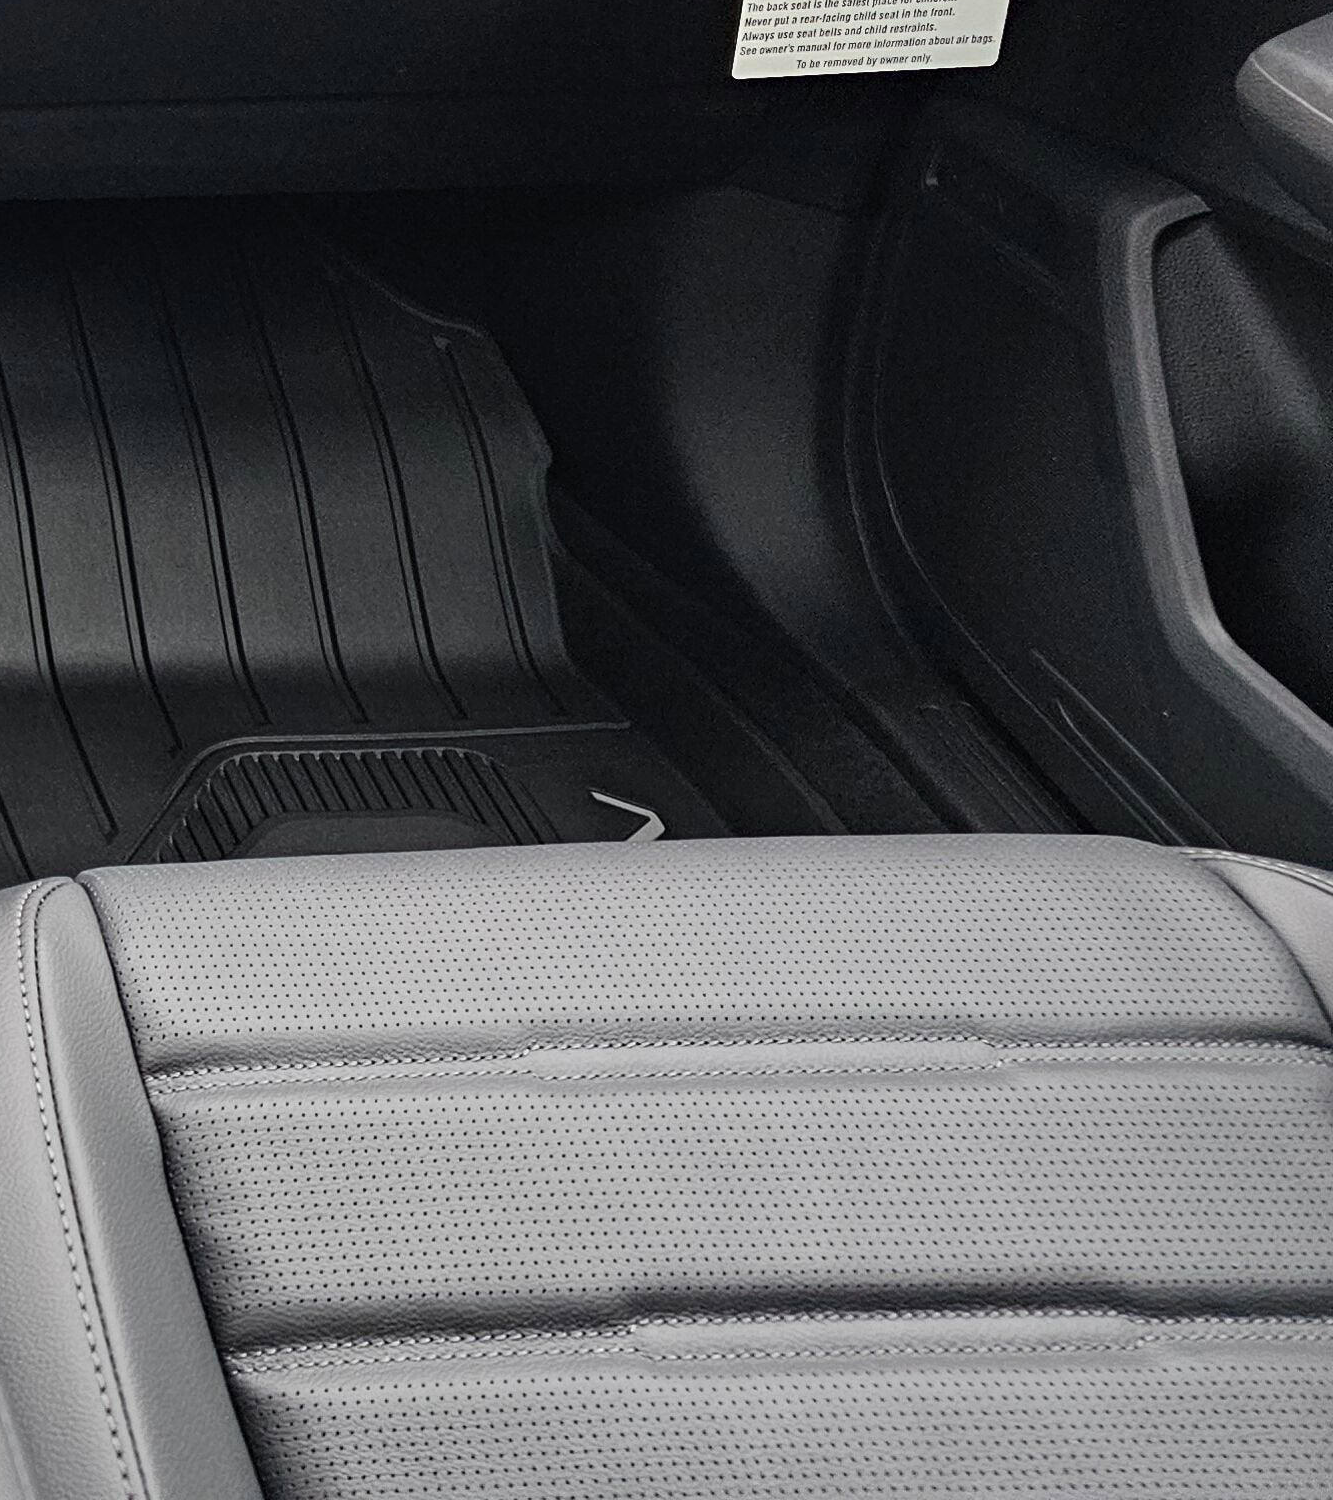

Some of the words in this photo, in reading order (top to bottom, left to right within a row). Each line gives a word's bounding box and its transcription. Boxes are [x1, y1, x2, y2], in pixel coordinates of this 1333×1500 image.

[747, 2, 764, 12] The
[766, 1, 788, 11] back
[790, 0, 812, 10] seat
[813, 0, 822, 9] is
[744, 17, 772, 27] Never
[774, 15, 789, 27] put
[800, 13, 851, 24] rear-facing
[853, 10, 877, 21] child
[879, 9, 900, 20] seat
[901, 9, 911, 19] in
[913, 8, 928, 18] the
[930, 7, 956, 17] front.
[741, 31, 775, 42] Always
[777, 30, 794, 39] use
[796, 28, 817, 39] seat
[819, 27, 842, 38] belts
[844, 26, 863, 36] and
[864, 24, 888, 34] child
[889, 22, 937, 33] restraints.
[739, 46, 757, 56] See
[759, 43, 795, 54] owner's
[796, 41, 831, 53] manual
[833, 41, 847, 51] for
[848, 41, 872, 50] more
[873, 37, 926, 48] information
[928, 36, 954, 46] about
[955, 34, 970, 44] air
[970, 34, 996, 45] bags.
[796, 59, 806, 69] To
[809, 58, 820, 68] be
[823, 56, 865, 68] removed
[866, 56, 877, 67] by
[879, 54, 909, 65] owner
[911, 53, 933, 65] only.
